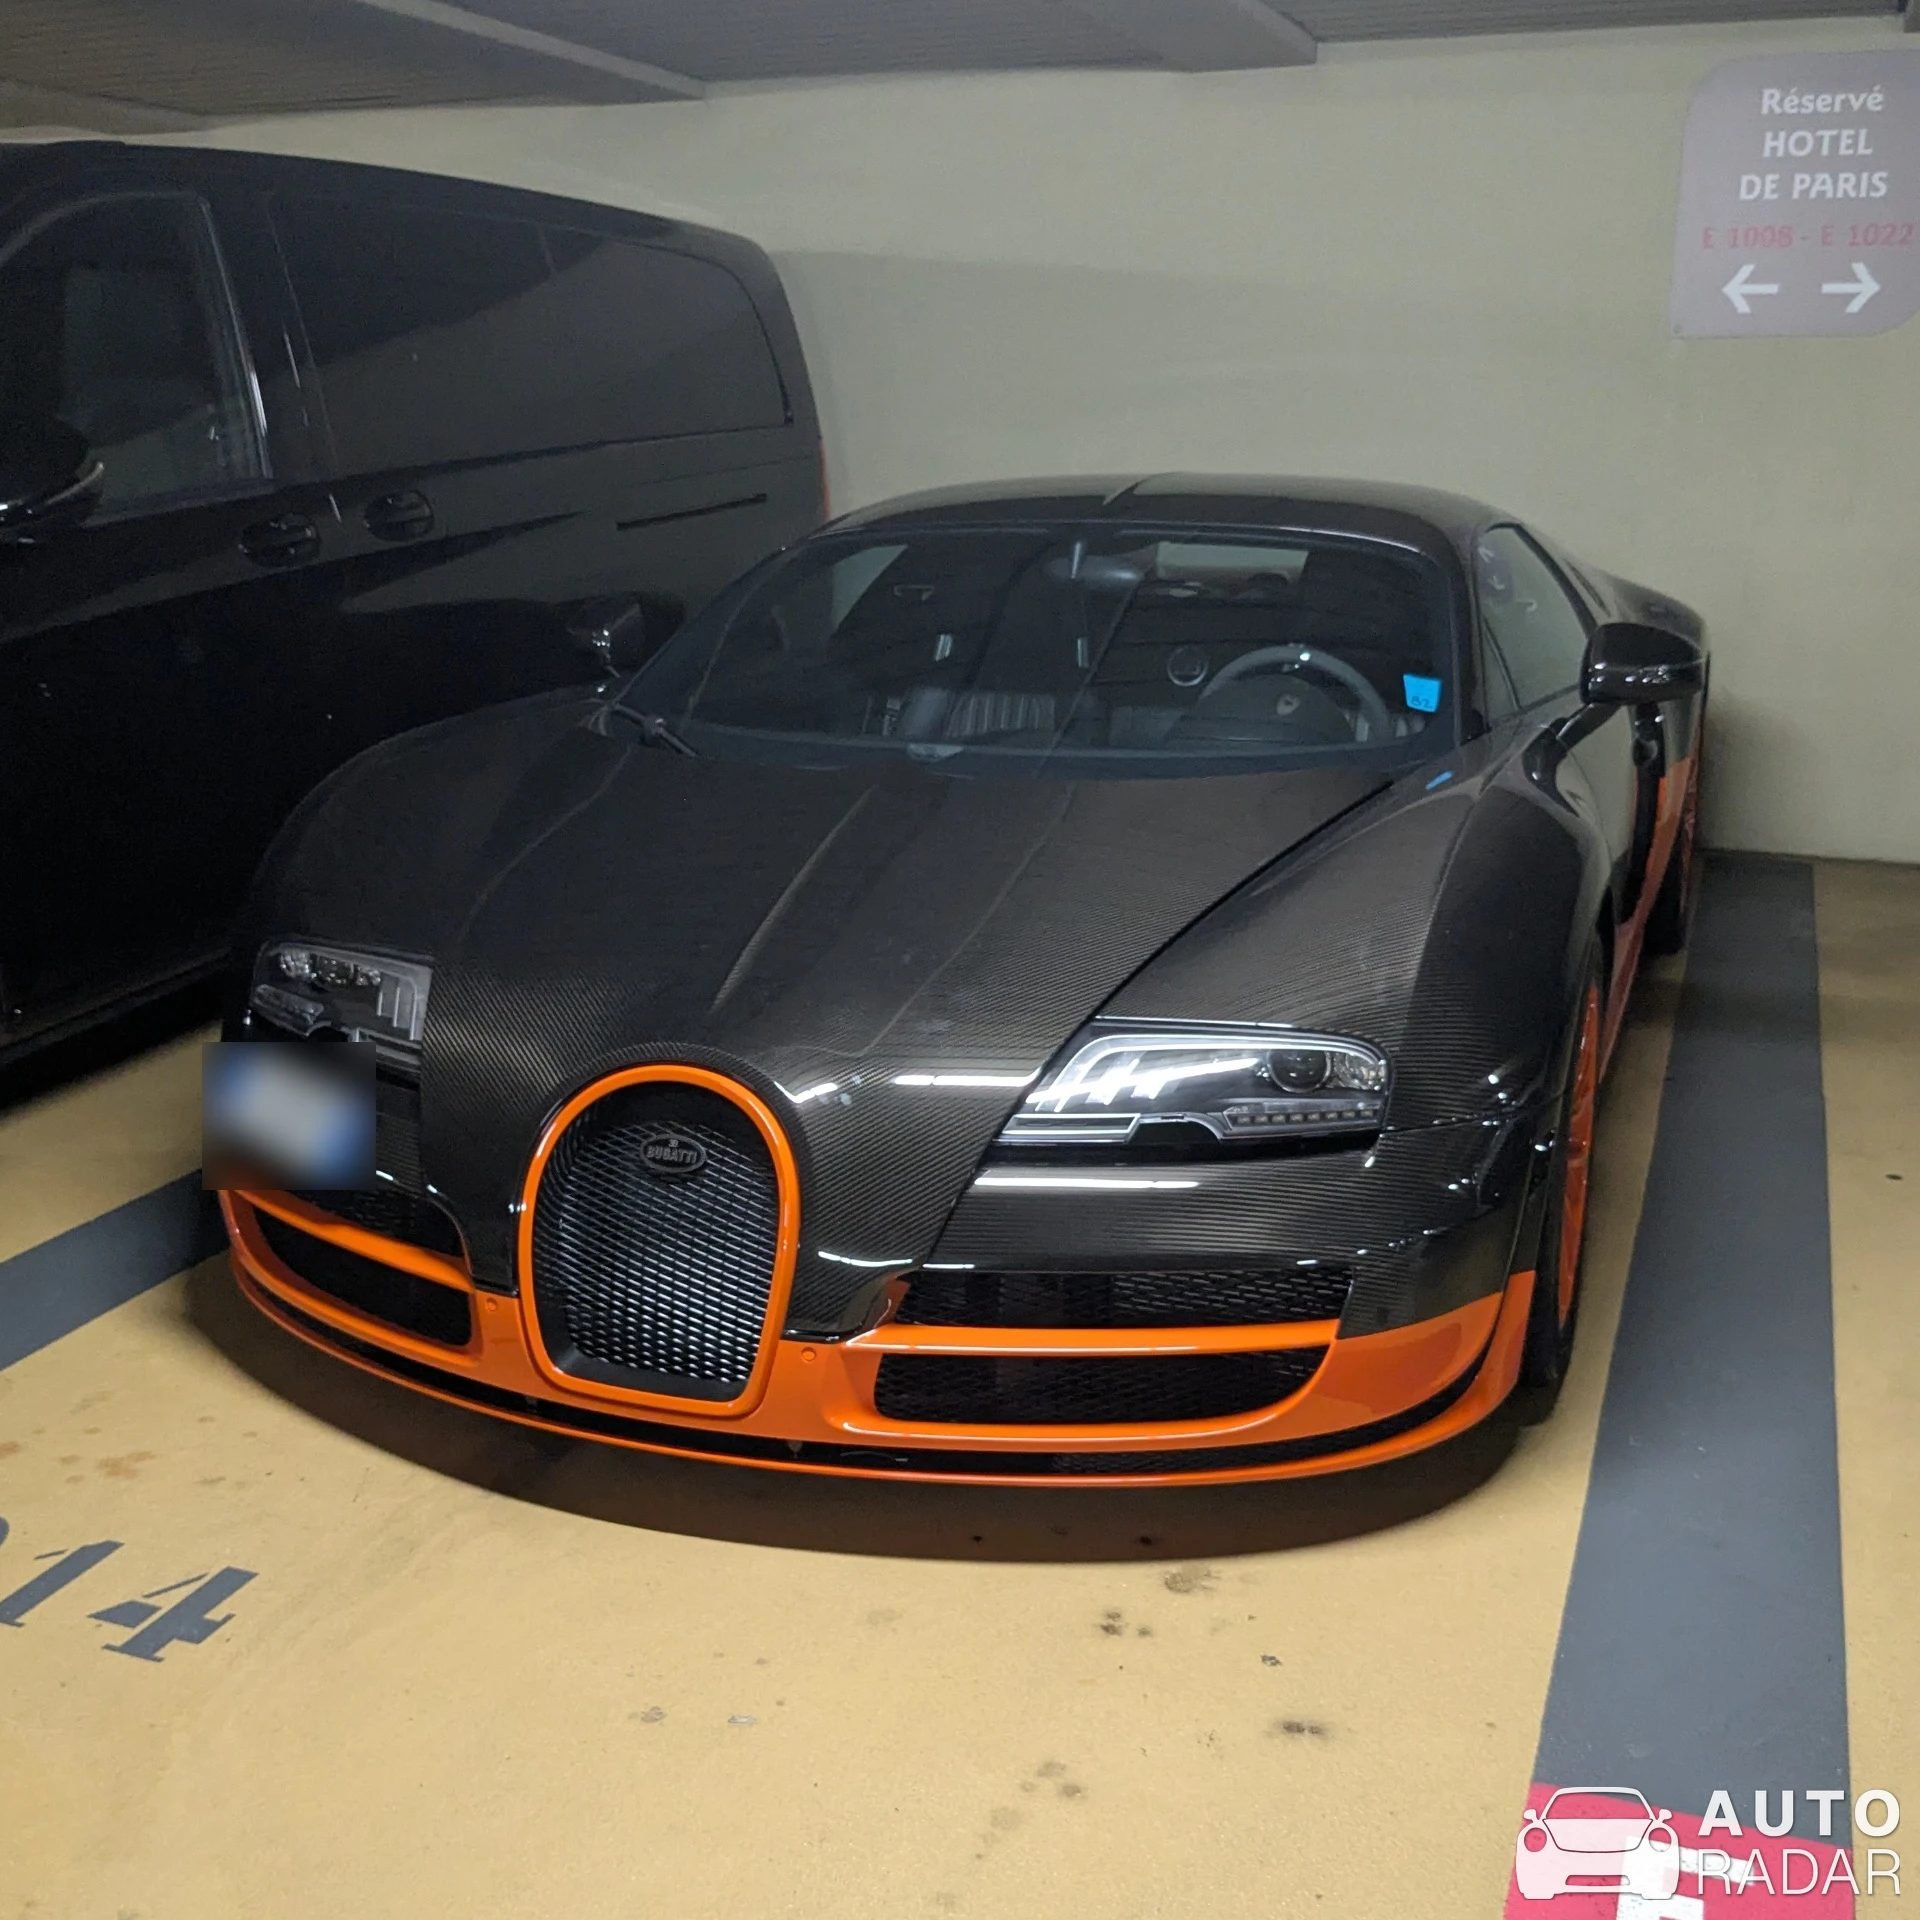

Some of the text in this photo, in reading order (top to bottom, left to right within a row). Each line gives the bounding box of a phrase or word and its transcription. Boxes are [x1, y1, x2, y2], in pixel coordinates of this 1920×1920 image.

[1760, 84, 1884, 115] Réservé
[1762, 128, 1874, 158] HOTEL
[1739, 171, 1889, 200] DE PARIS
[1702, 225, 1714, 249] E
[1820, 224, 1835, 247] E
[1848, 222, 1915, 247] 1022
[647, 1146, 697, 1163] BUGATTI
[0, 1515, 260, 1663] 14
